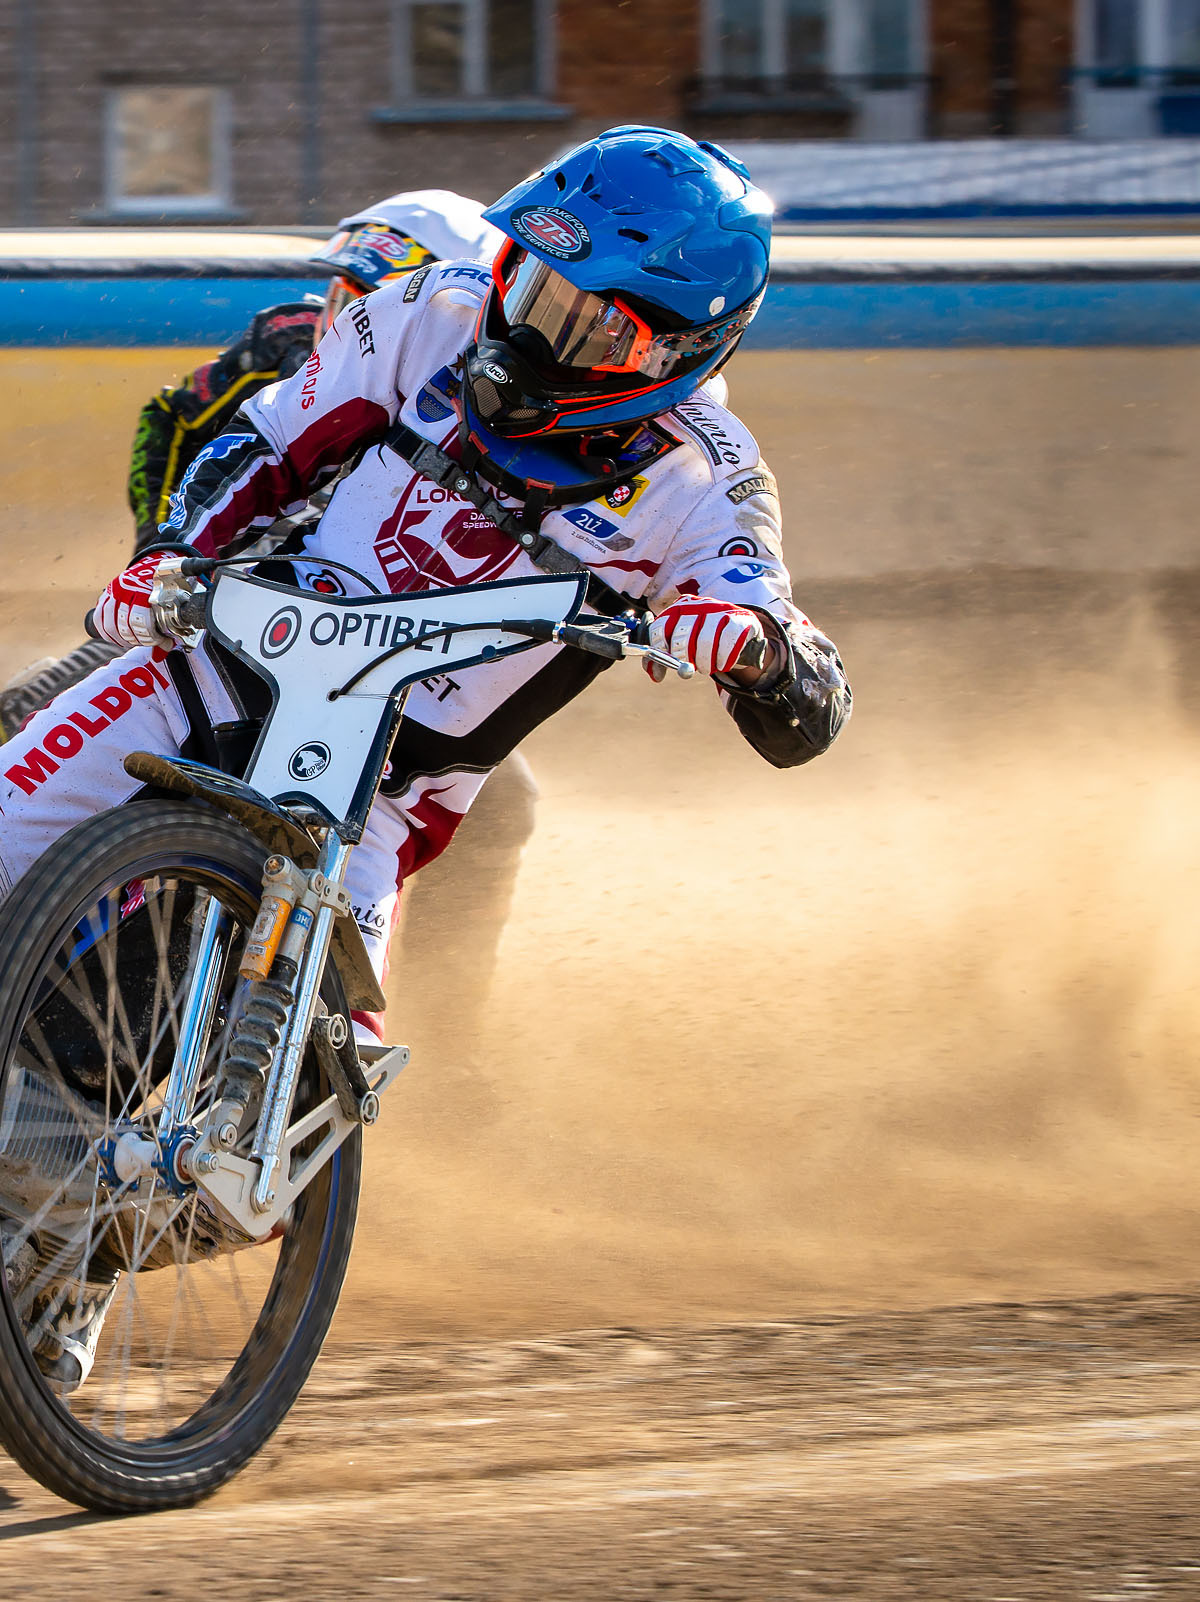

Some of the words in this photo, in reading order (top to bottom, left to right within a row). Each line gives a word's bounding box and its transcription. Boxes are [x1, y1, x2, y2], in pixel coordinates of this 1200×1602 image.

[523, 213, 579, 248] STS
[536, 206, 590, 243] STAKEFORD
[524, 234, 570, 259] SERVICES
[485, 365, 506, 380] Arai
[576, 513, 602, 533] 2LŻ
[309, 612, 463, 654] OPTIBET
